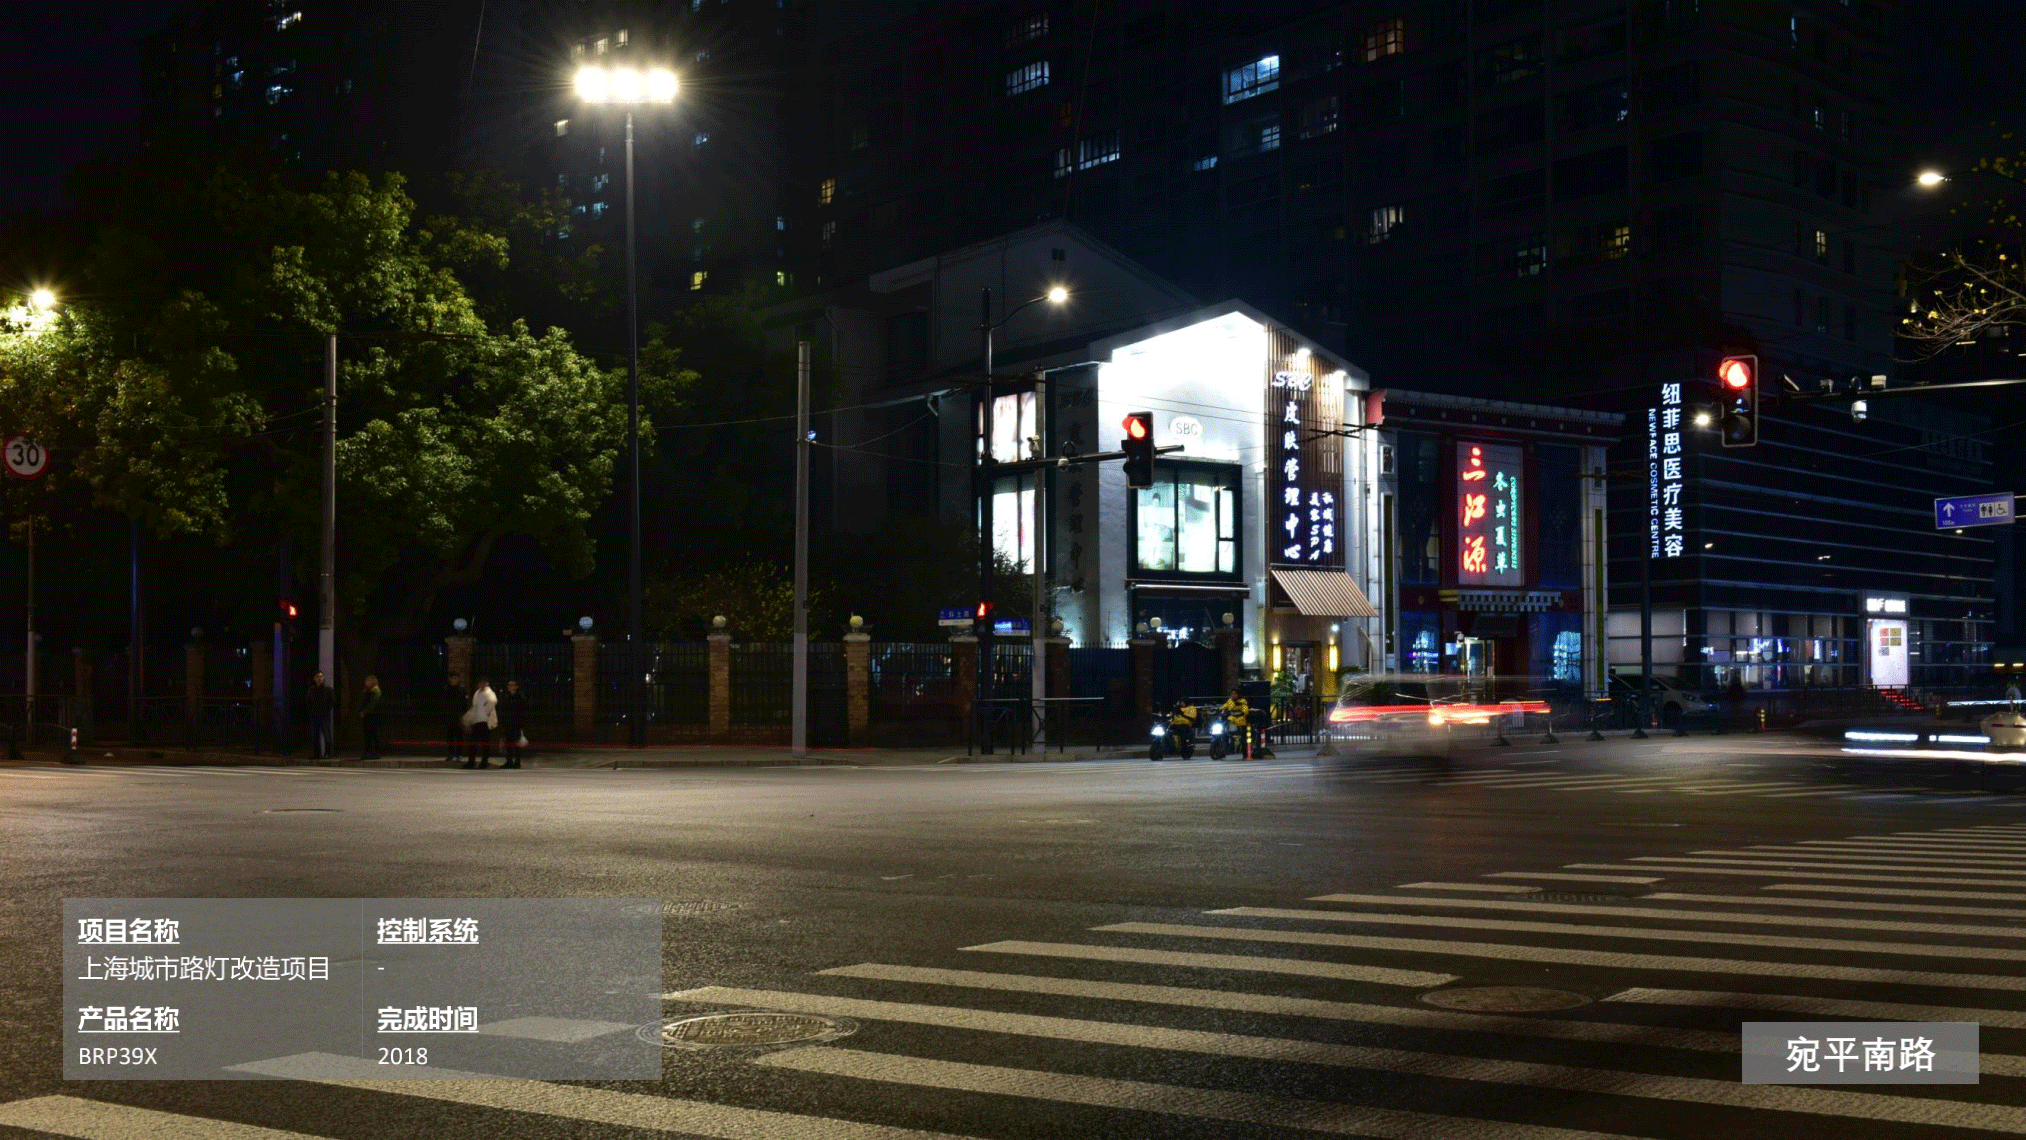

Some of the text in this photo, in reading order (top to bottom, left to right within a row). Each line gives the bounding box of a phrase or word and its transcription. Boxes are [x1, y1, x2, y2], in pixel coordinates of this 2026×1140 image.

[12, 443, 40, 467] 30
[1175, 421, 1198, 436] SBC
[1284, 401, 1301, 559] 皮肤管理中心
[1648, 408, 1660, 559] NEWFACE COSMETIC CENTRE
[1661, 382, 1684, 558] 纽菲思医疗美容
[1463, 446, 1487, 573] 三江源
[1493, 471, 1508, 574] 冬虫夏草
